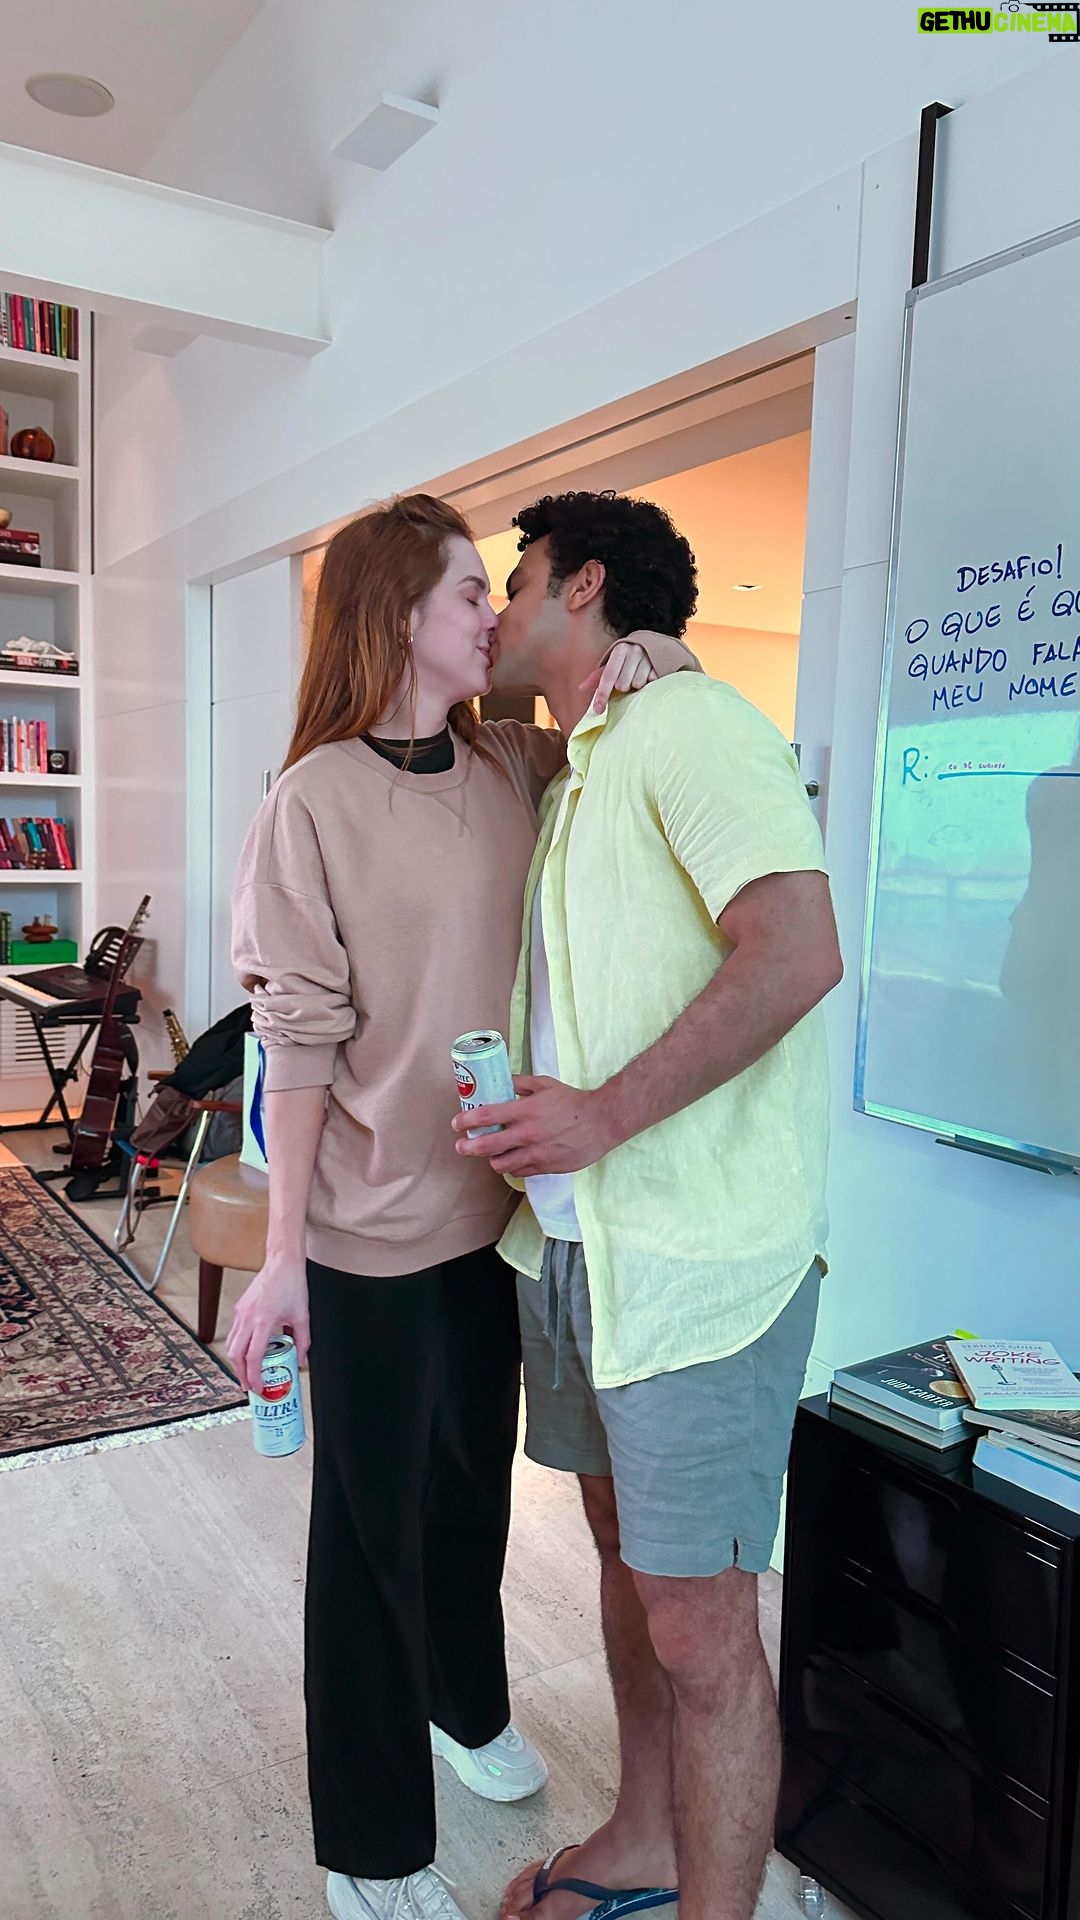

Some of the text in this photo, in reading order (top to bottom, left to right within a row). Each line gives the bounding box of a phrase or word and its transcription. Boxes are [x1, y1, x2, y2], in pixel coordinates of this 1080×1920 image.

[956, 543, 1063, 593] DESAFIO!
[904, 618, 930, 645] O
[941, 604, 1001, 643] QUE
[1017, 584, 1036, 622] É
[907, 648, 1007, 682] QUANDO
[931, 671, 1078, 711] MEU NOME
[963, 1356, 1061, 1366] WRITING
[974, 1350, 1043, 1358] JOKE
[254, 1398, 299, 1417] ULTRA
[880, 1378, 955, 1408] JUDY CARTER
